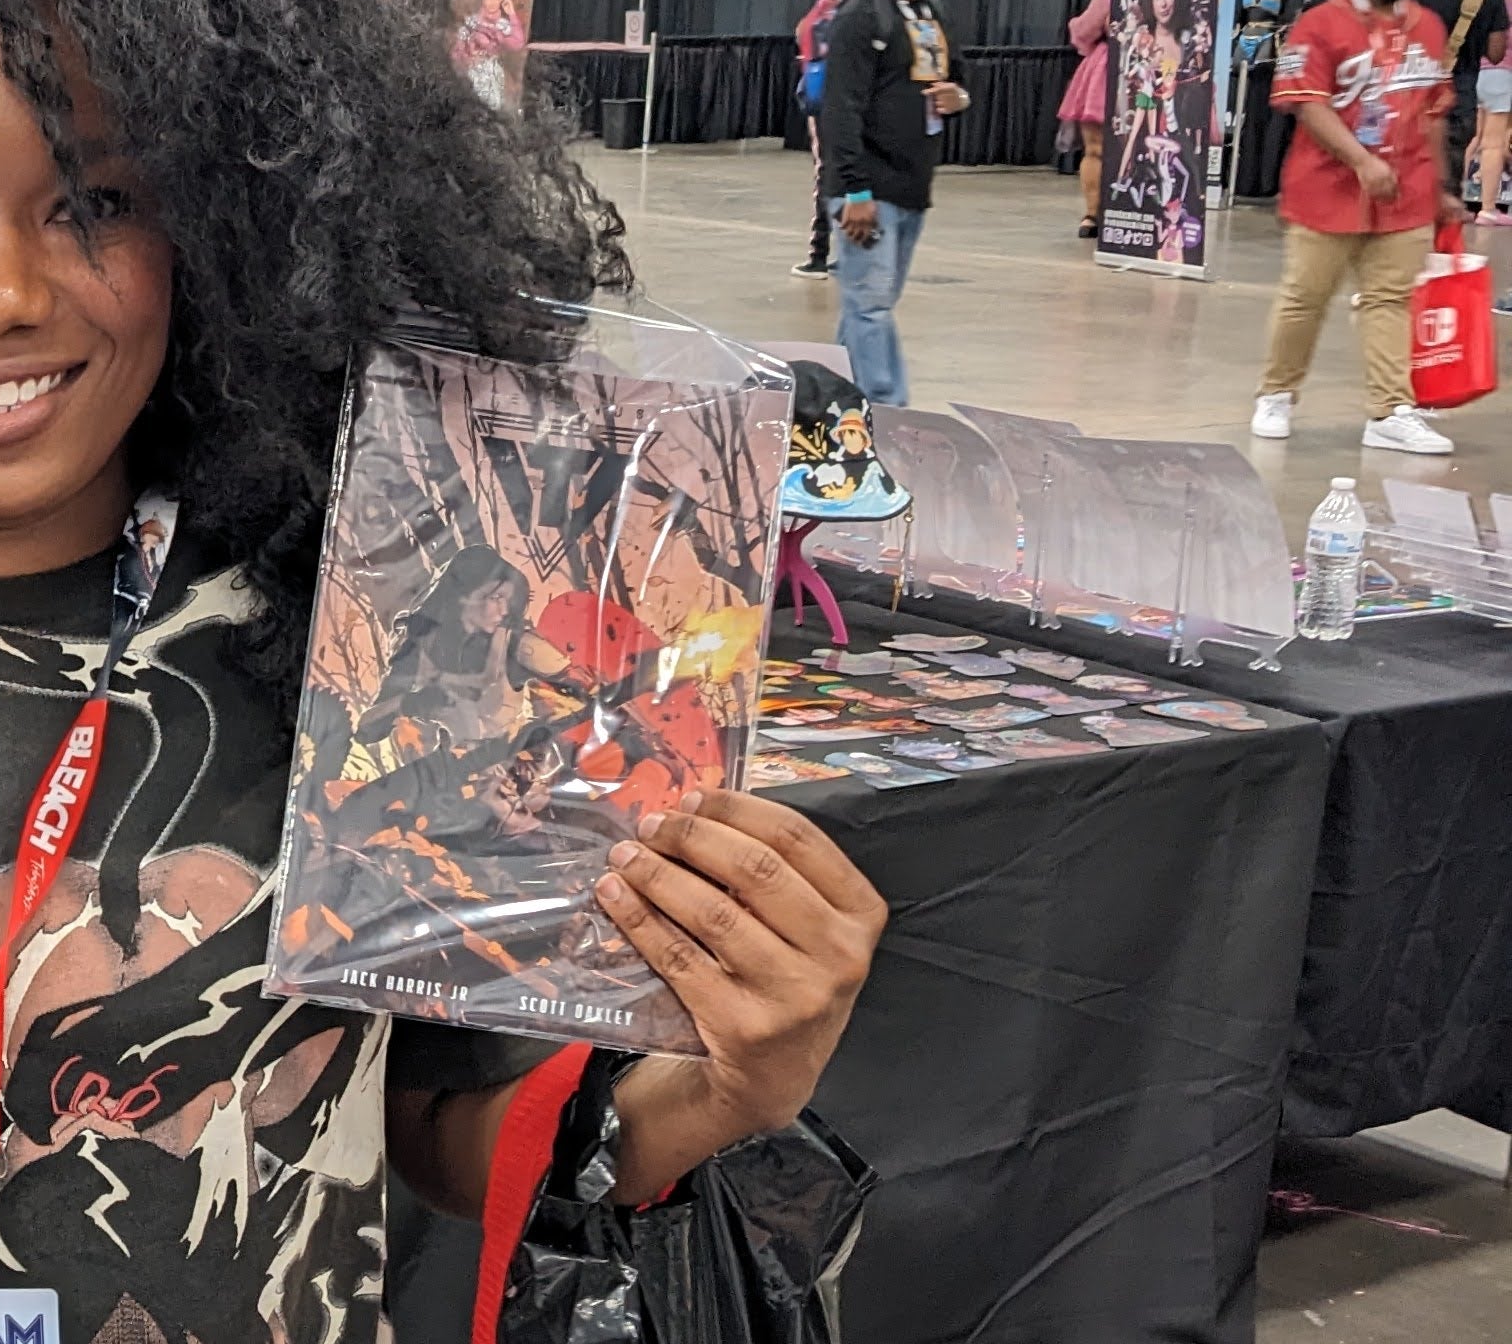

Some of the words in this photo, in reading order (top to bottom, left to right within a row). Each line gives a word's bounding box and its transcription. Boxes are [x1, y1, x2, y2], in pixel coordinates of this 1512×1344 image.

[29, 726, 95, 856] BLEACH
[340, 969, 377, 988] JACK
[386, 975, 442, 998] HARRIS
[450, 985, 468, 1002] JR
[519, 996, 566, 1016] SCOTT
